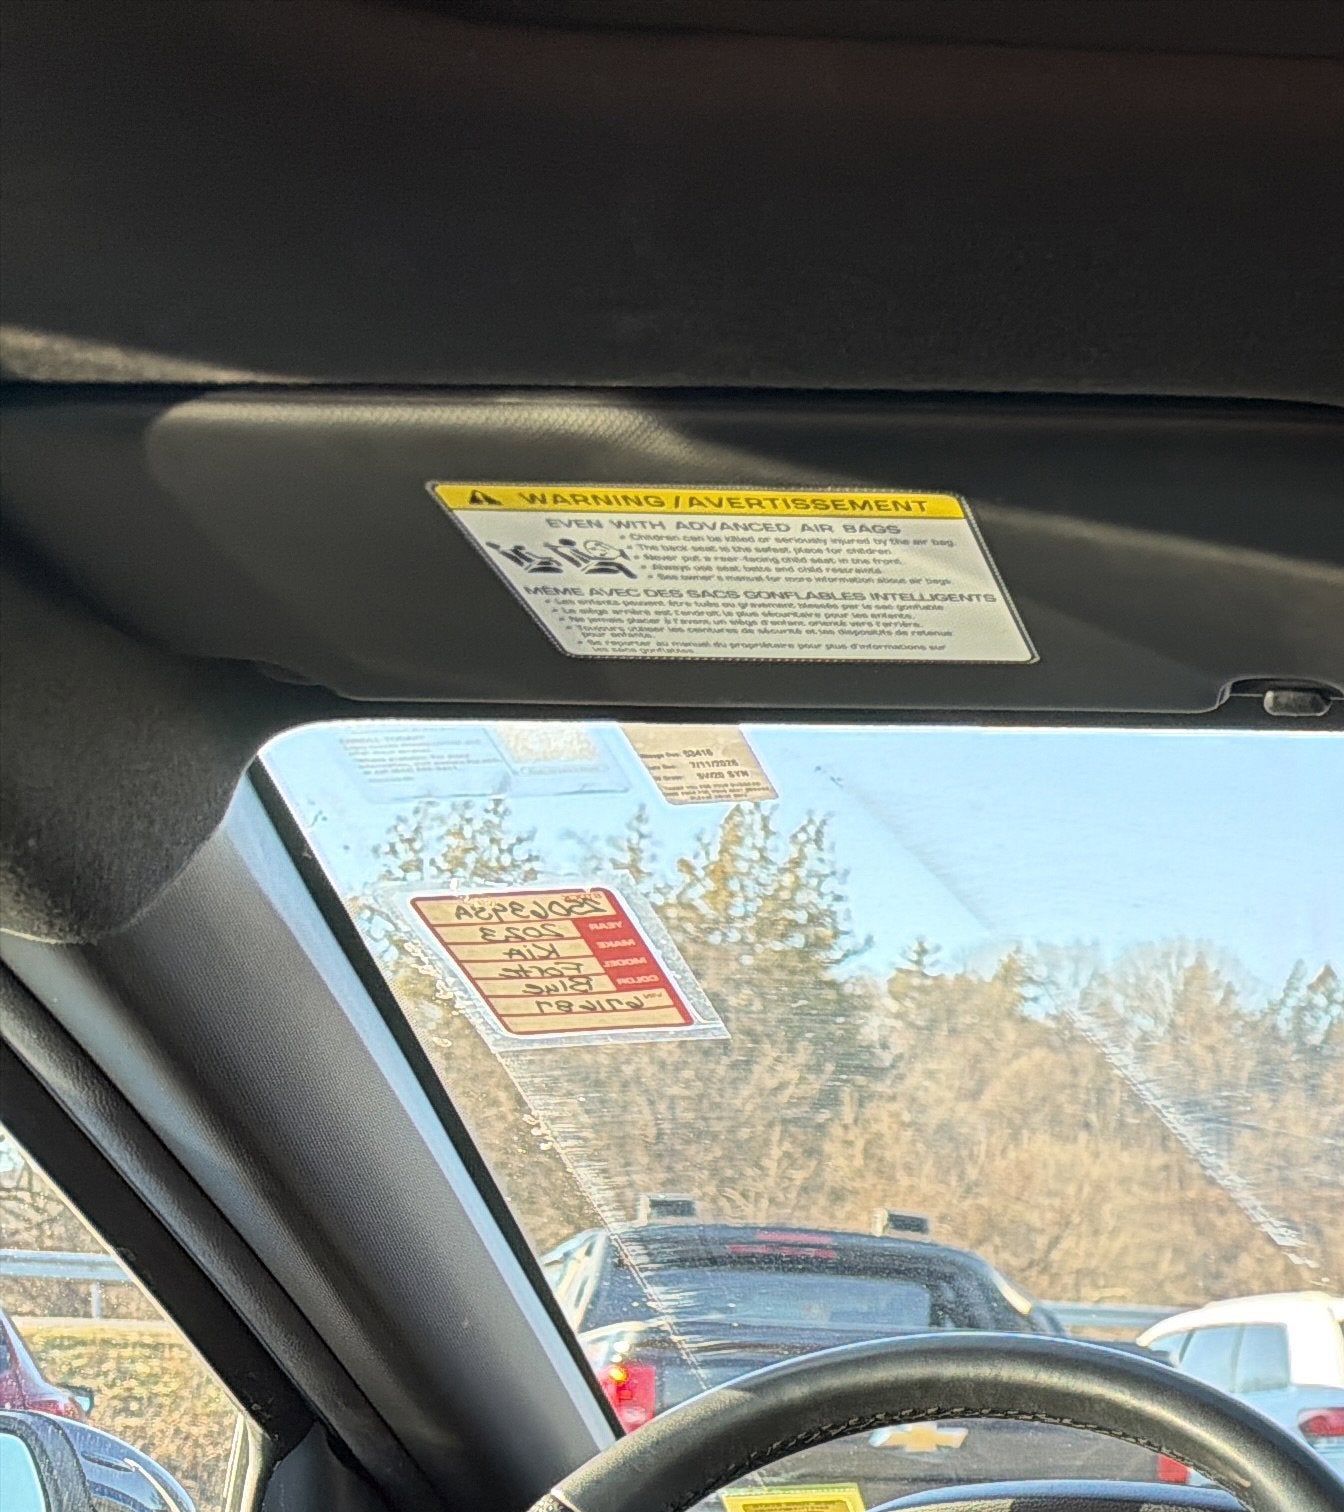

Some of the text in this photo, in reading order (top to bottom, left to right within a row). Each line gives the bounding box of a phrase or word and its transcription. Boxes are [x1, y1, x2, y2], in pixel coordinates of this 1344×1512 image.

[518, 491, 666, 509] WARNING
[688, 495, 928, 512] AVERTISSEMENT
[546, 518, 902, 534] EVEN WITH ADVANCED AIR BAGS
[524, 585, 997, 603] MÊME AVEC DES SACS GONFLABLES INTELLIGENTS
